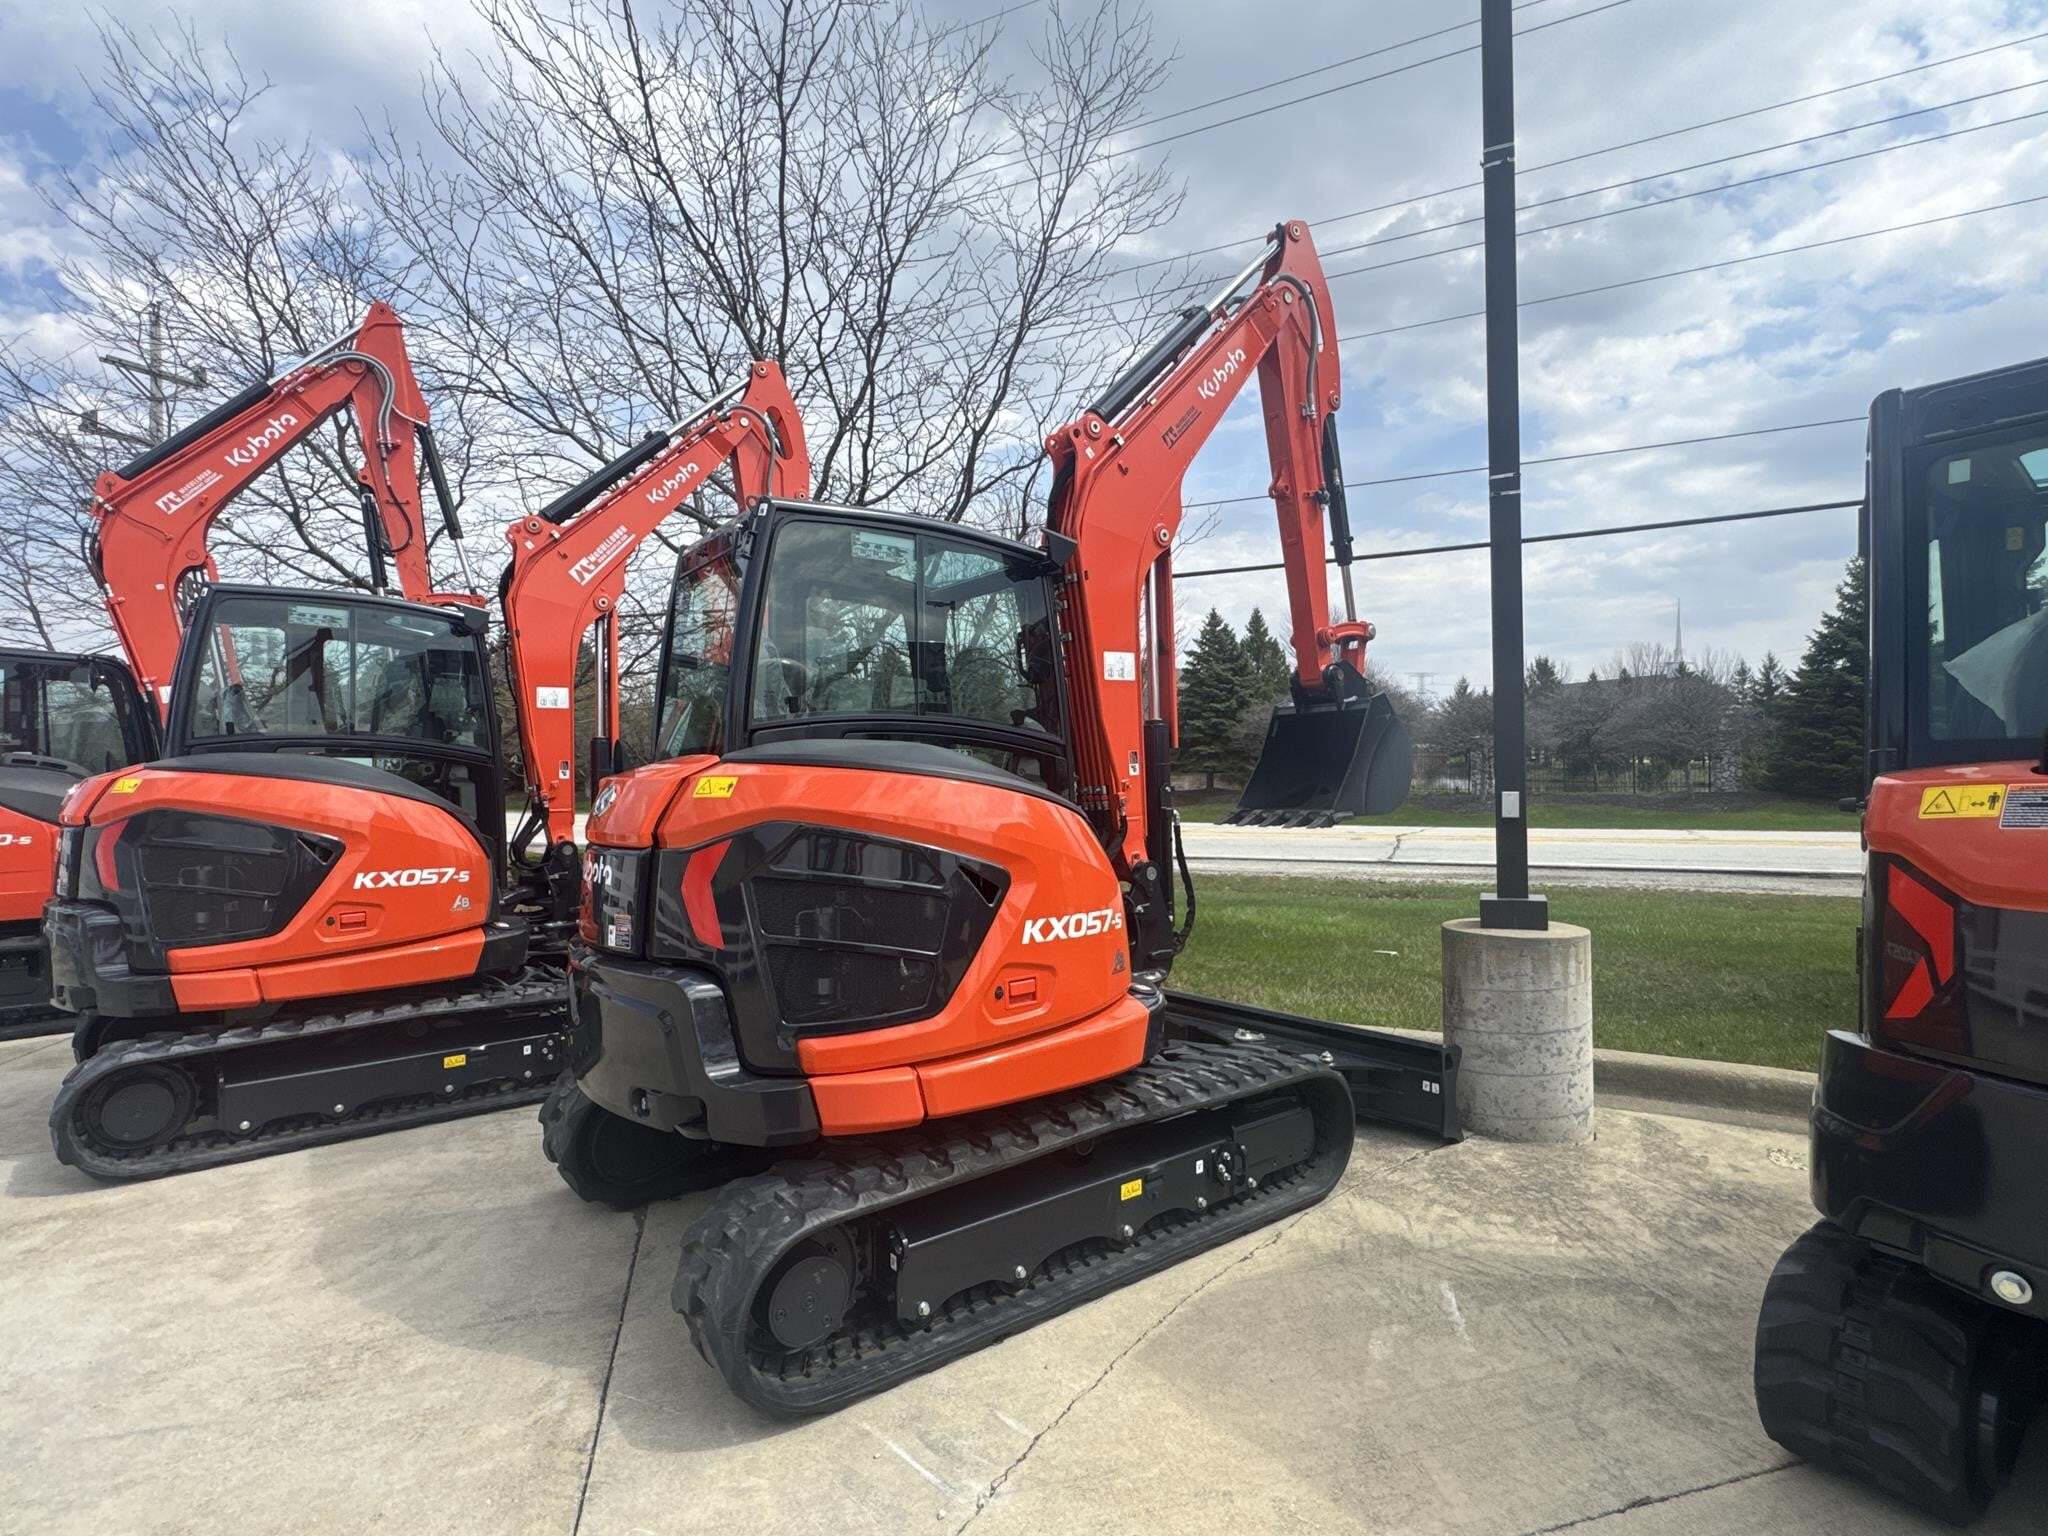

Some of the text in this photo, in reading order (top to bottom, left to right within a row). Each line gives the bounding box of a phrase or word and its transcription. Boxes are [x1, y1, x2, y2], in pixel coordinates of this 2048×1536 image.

[1198, 348, 1247, 400] Kubota
[223, 413, 299, 467] Kubota
[645, 462, 700, 504] Kubota
